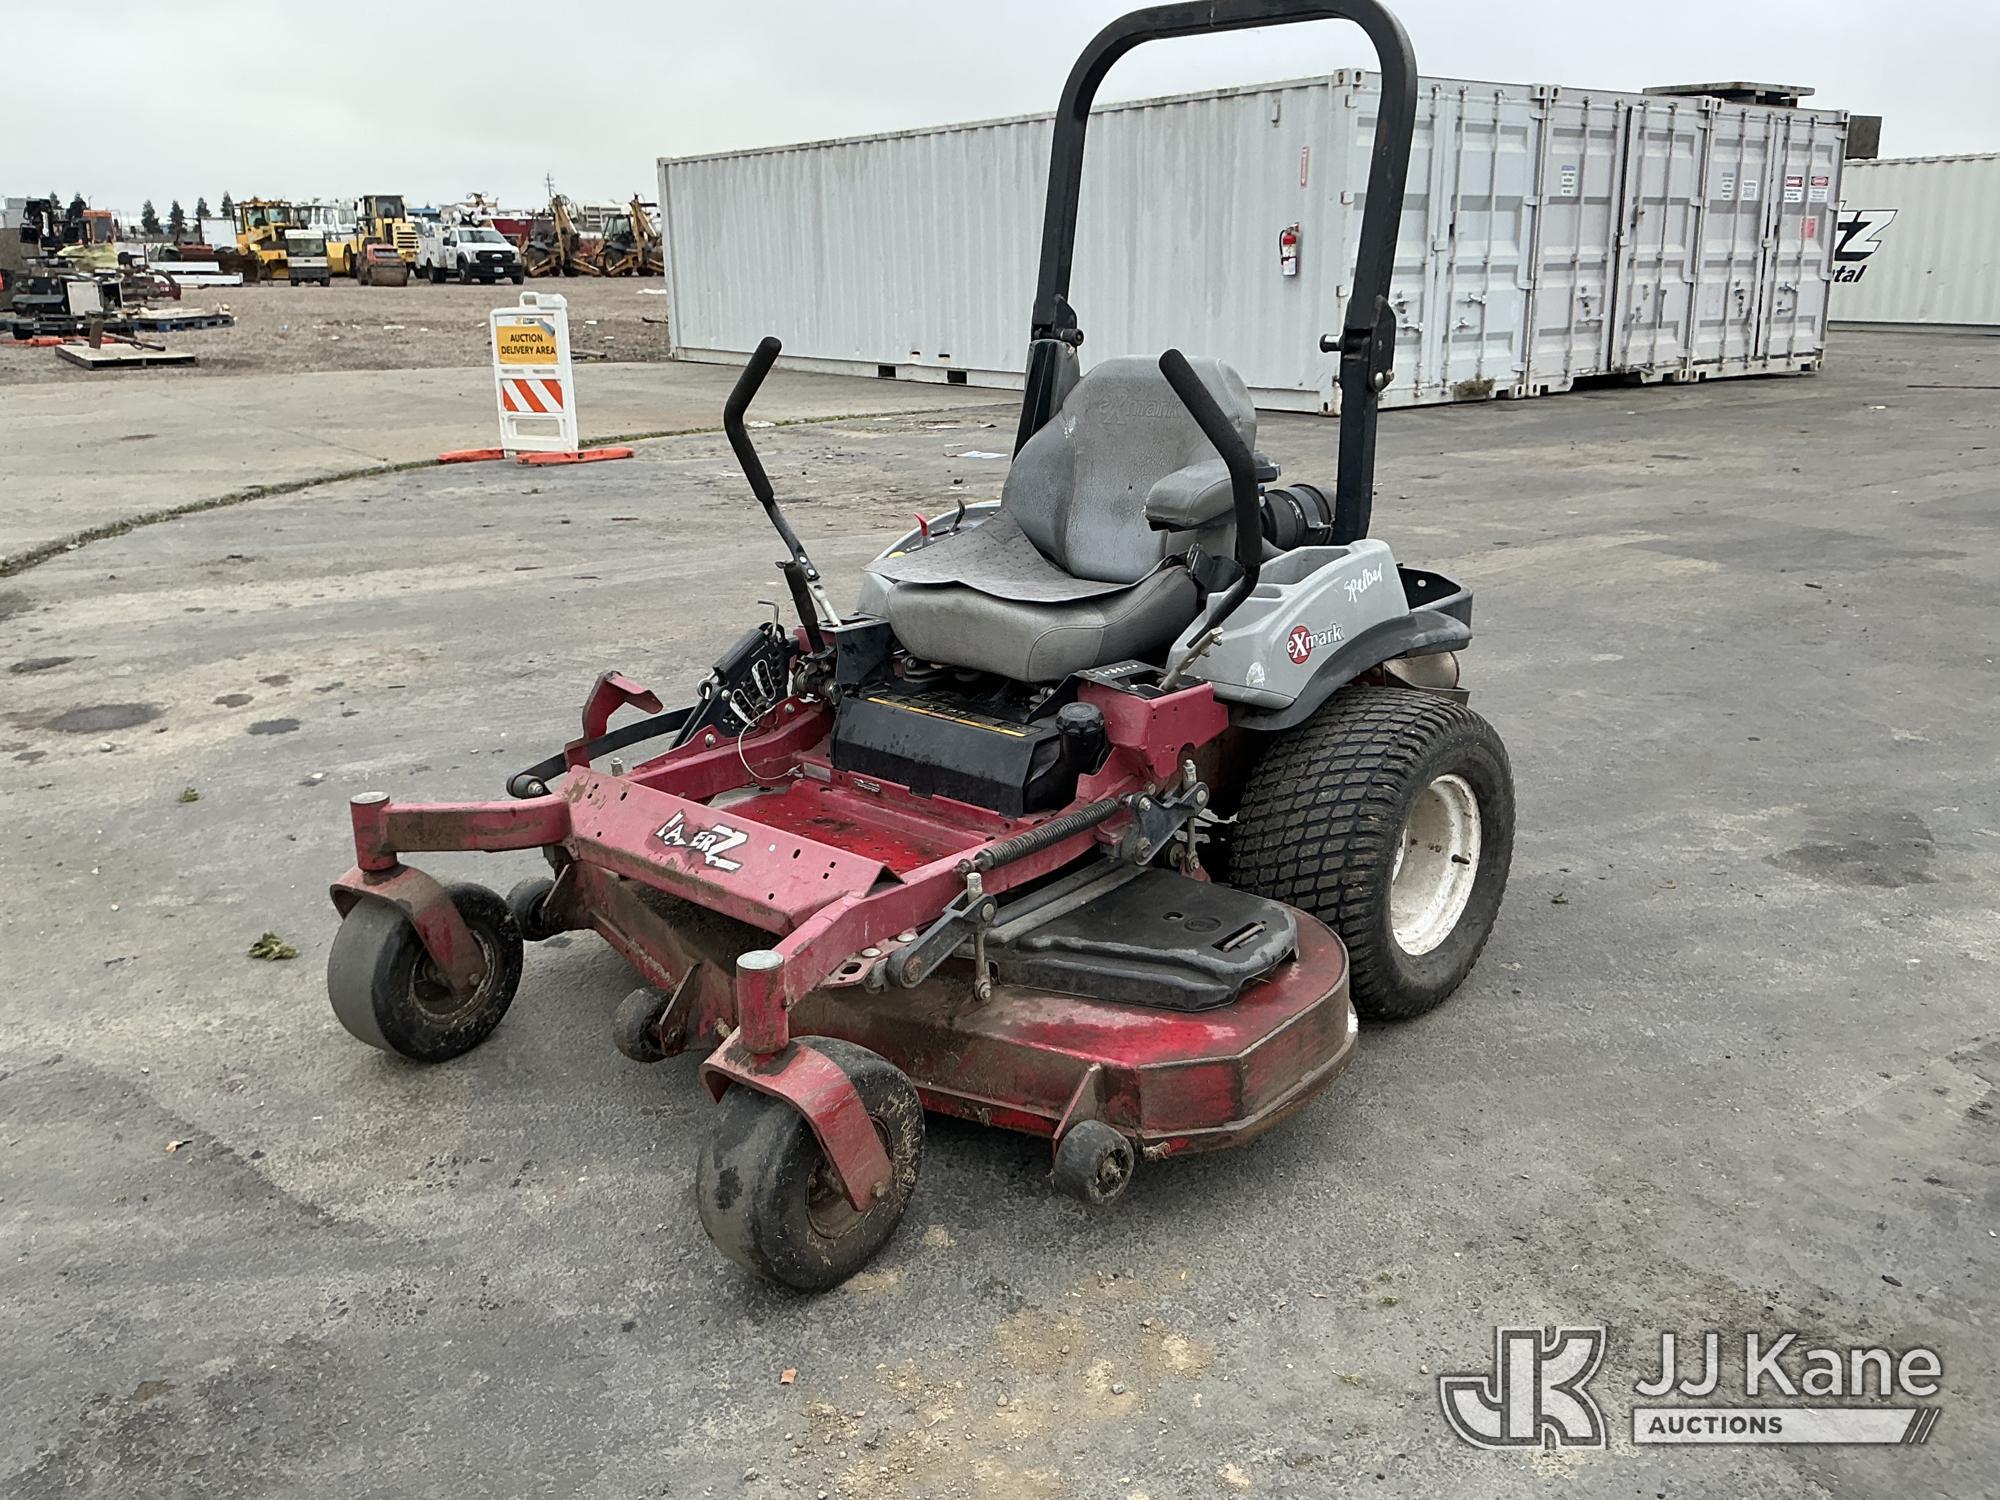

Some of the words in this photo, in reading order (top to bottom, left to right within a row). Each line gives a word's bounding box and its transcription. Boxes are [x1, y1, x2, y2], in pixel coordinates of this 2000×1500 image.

[510, 333, 543, 342] AUCTION
[501, 345, 534, 354] DELIVERY
[536, 345, 556, 354] AREA
[1286, 623, 1343, 659] eXmark
